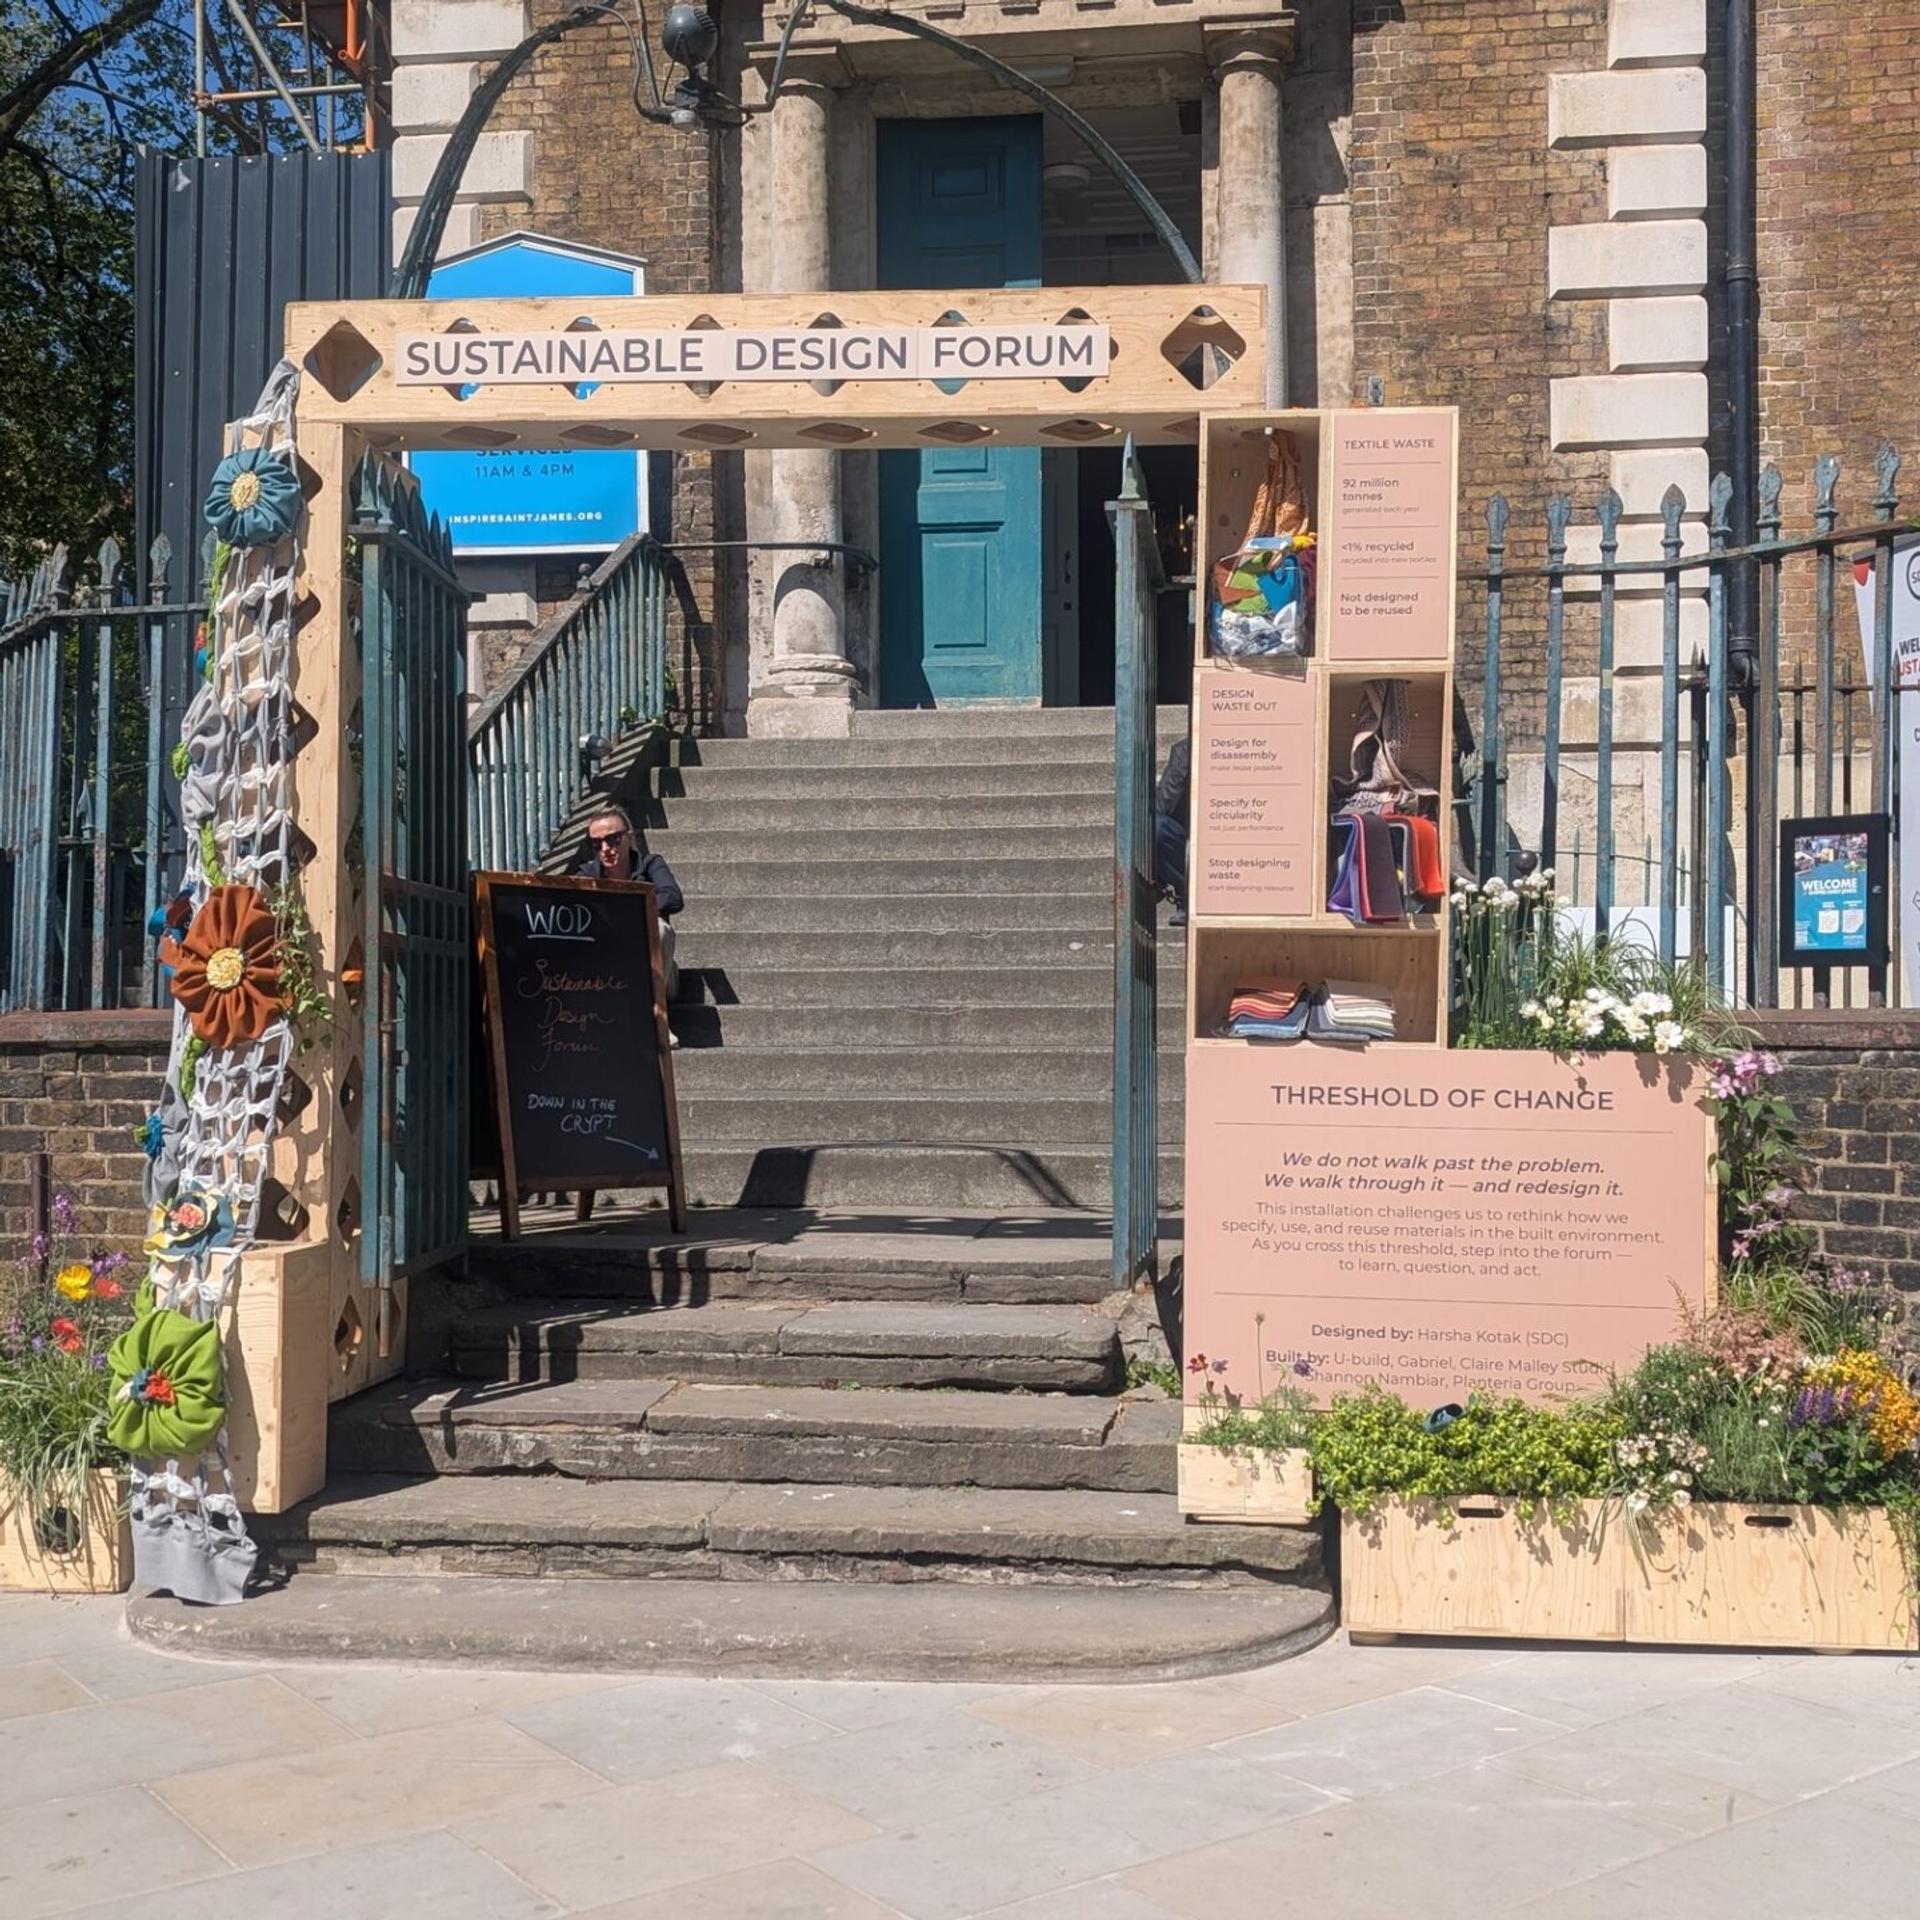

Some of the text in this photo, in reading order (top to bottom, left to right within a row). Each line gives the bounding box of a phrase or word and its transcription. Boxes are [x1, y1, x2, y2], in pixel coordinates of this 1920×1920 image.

[406, 335, 1093, 376] SUSTAINABLE DESIGN FORUM
[1344, 439, 1435, 450] TEXTILE WASTE
[475, 464, 574, 478] 11AM & 4PM
[1342, 477, 1400, 488] 92 million
[1342, 493, 1383, 501] tonnes
[449, 512, 602, 524] INSPIRESAINTJAMES.ORG
[1341, 541, 1414, 553] <1% recycled
[1341, 592, 1419, 603] Not designed
[1340, 605, 1412, 615] to be reused
[1212, 689, 1254, 699] DESIGN
[1212, 702, 1277, 712] WASTE OUT
[1211, 738, 1267, 749] Design for
[1210, 751, 1277, 761] disassembly
[1210, 798, 1267, 809] Specify for
[1209, 811, 1263, 821] circularity
[1209, 858, 1290, 869] Stop designing
[1209, 872, 1240, 880] waste
[1801, 878, 1857, 890] WELCOME
[525, 903, 591, 934] WOD
[528, 1094, 617, 1111] DOWN IN THE
[1271, 1085, 1614, 1111] THRESHOLD OF CHANGE
[560, 1114, 617, 1134] CRYPT
[1283, 1152, 1605, 1175] We do not walk past the problem.
[1264, 1173, 1294, 1188] We
[1299, 1175, 1342, 1189] walk
[1349, 1175, 1425, 1194] through
[1430, 1177, 1444, 1191] it
[1472, 1179, 1510, 1194] and
[1515, 1179, 1600, 1198] redesign
[1605, 1180, 1623, 1196] it.
[1256, 1202, 1628, 1224] This installation challenges us to rethink how we
[1222, 1219, 1664, 1244] specify, use, and reuse materials in the built environment.
[1251, 1238, 1270, 1250] As
[1273, 1241, 1300, 1254] you
[1305, 1242, 1344, 1253] cross
[1348, 1241, 1376, 1254] this
[1380, 1241, 1458, 1257] threshold,
[1461, 1244, 1495, 1260] step
[1499, 1245, 1530, 1258] into
[1533, 1245, 1560, 1259] the
[1564, 1246, 1612, 1260] forum
[1338, 1259, 1541, 1277] to learn, question, and act.
[1312, 1324, 1569, 1348] Designed by: Harsha Kotak (SDC)
[1266, 1350, 1301, 1363] Built
[1308, 1351, 1330, 1366] by:
[1334, 1352, 1394, 1368] U-build,
[1398, 1355, 1456, 1371] Gabriel,
[1460, 1357, 1504, 1371] Claire
[1508, 1359, 1559, 1375] Malley
[1306, 1370, 1374, 1384] Shannon
[1379, 1373, 1449, 1388] Nambiar,
[1453, 1375, 1522, 1391] Planteria
